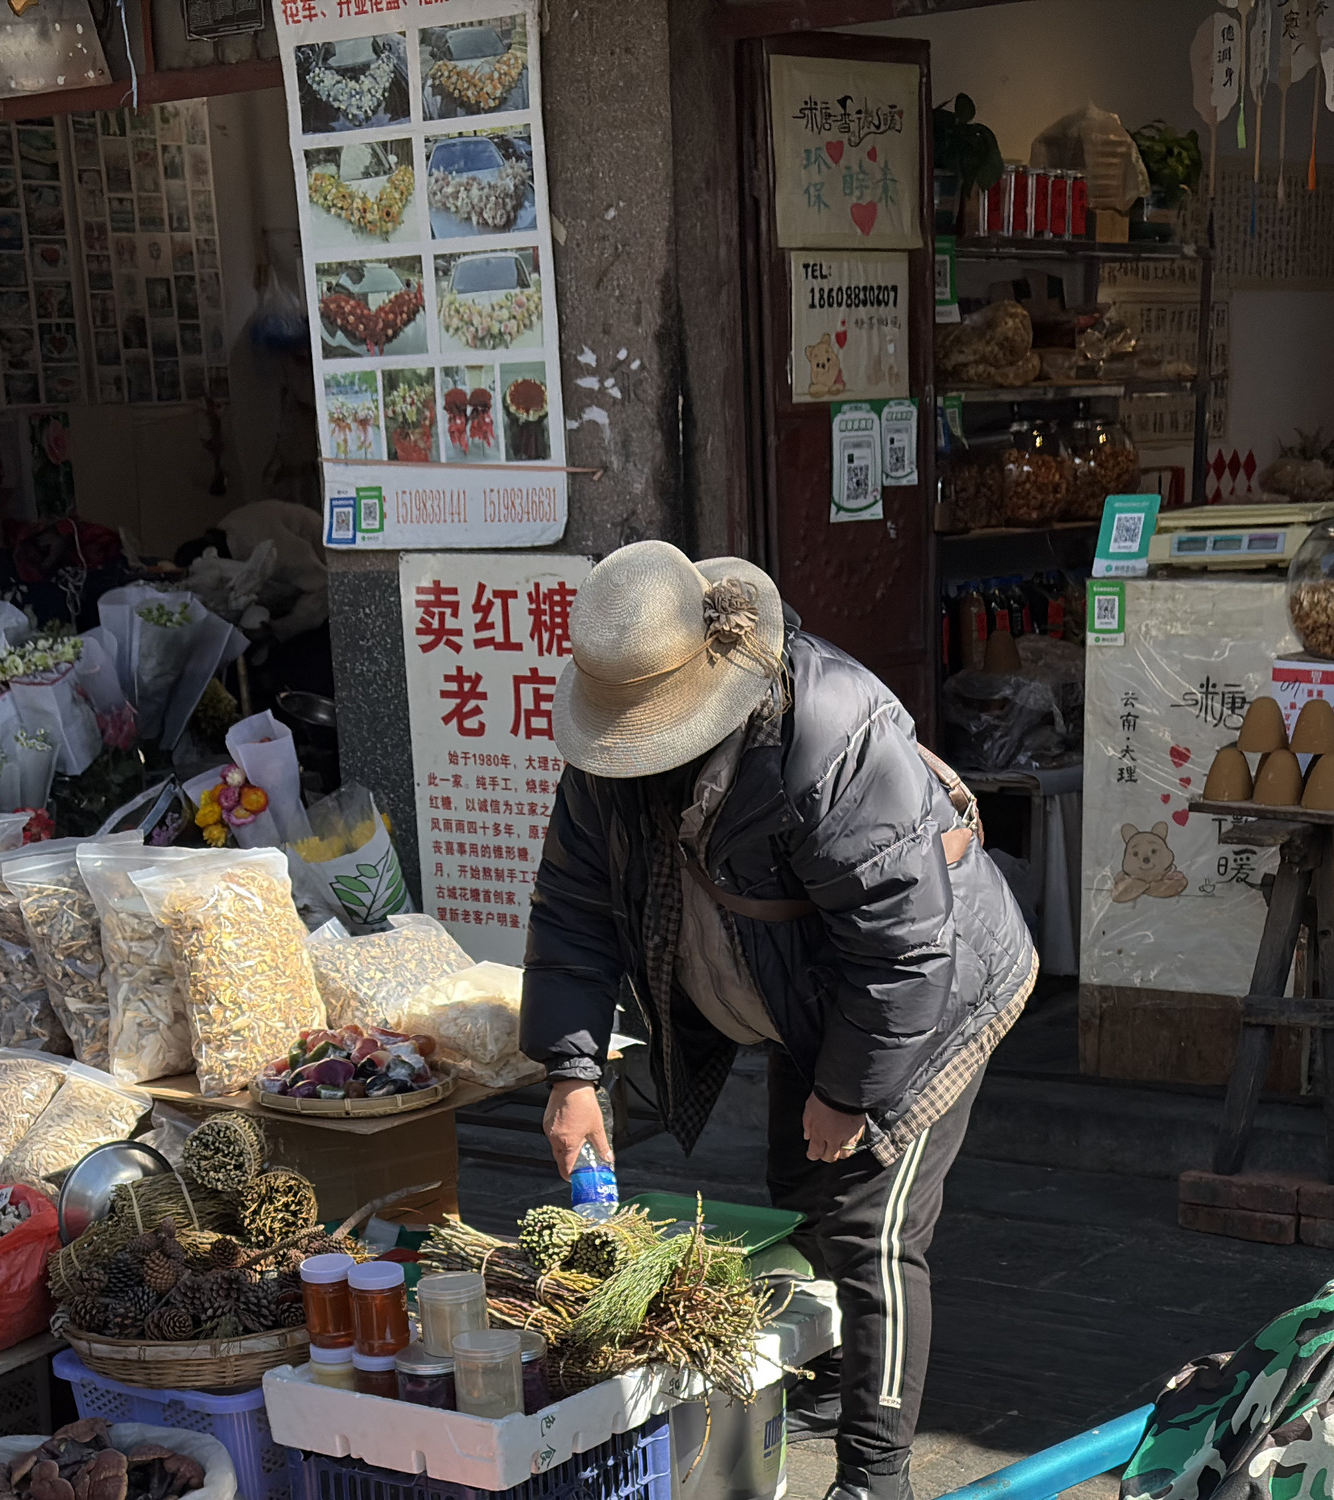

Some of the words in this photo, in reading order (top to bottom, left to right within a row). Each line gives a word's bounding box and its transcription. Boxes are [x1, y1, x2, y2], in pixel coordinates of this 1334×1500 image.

[414, 579, 578, 657] 卖红糖
[439, 665, 557, 741] 老店
